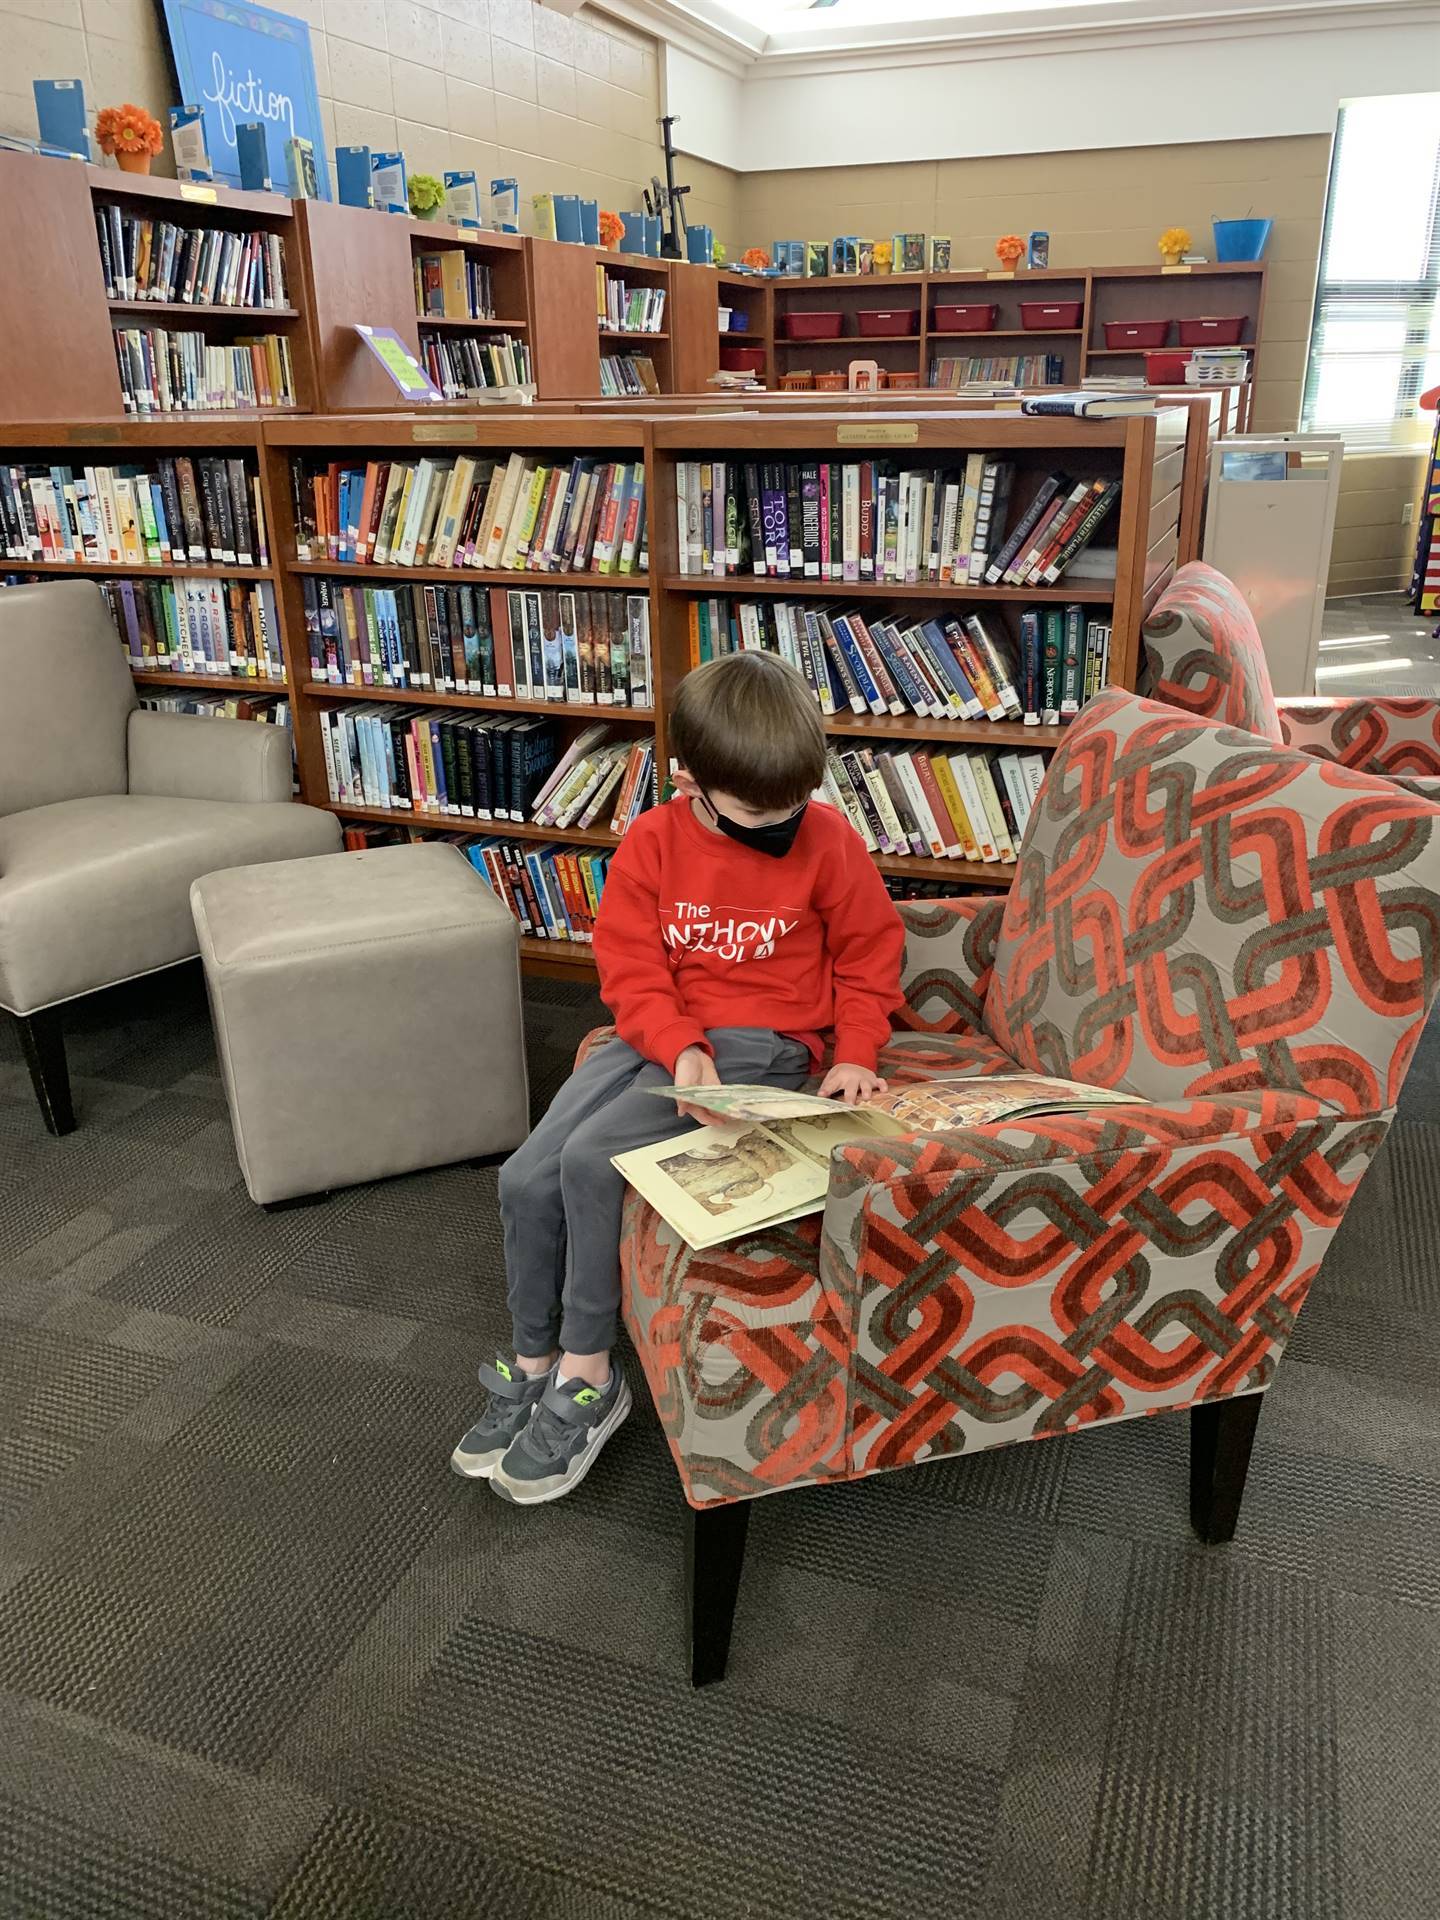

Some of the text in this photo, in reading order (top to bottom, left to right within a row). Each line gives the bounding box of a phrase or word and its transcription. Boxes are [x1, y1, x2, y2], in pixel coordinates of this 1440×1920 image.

[203, 51, 294, 146] fiction
[182, 473, 190, 495] City
[187, 504, 199, 532] Glass
[215, 472, 224, 513] Clockwork
[803, 470, 819, 548] HALE DANGEROUS
[103, 497, 113, 535] SUMMERLAND
[207, 496, 217, 531] Heavenly
[237, 516, 245, 547] Princess
[726, 497, 737, 548] CAUGH
[749, 497, 761, 541] SENT
[764, 501, 776, 545] TOR
[774, 496, 786, 556] TORN
[861, 500, 871, 538] BUDDY
[1079, 503, 1107, 540] ELEVENTH
[1062, 536, 1083, 561] PLAGUE
[320, 581, 330, 608] FARMER
[178, 607, 189, 659] MATCHED
[188, 606, 199, 651] CROSSE
[212, 608, 225, 661] REACHED
[804, 660, 813, 680] STAR
[812, 641, 826, 689] STORMBREA
[831, 646, 847, 681] RAVEN'S
[848, 644, 872, 693] SCORPIA
[887, 651, 918, 697] SKELETON KEY
[902, 655, 933, 703] RAVEN'S GATE
[1046, 667, 1056, 708] NECROPOLIS
[1065, 669, 1075, 702] CROCODILE TEA
[396, 734, 408, 793] RECKLESS
[511, 740, 521, 775] BEAUTIFUL
[844, 758, 859, 787] JACQUES
[850, 758, 862, 782] BRIAN
[1029, 767, 1039, 798] TAGGE
[502, 846, 511, 863] GREEN
[514, 849, 523, 866] GREEN
[675, 902, 711, 919] The
[661, 917, 799, 949] NTHONY
